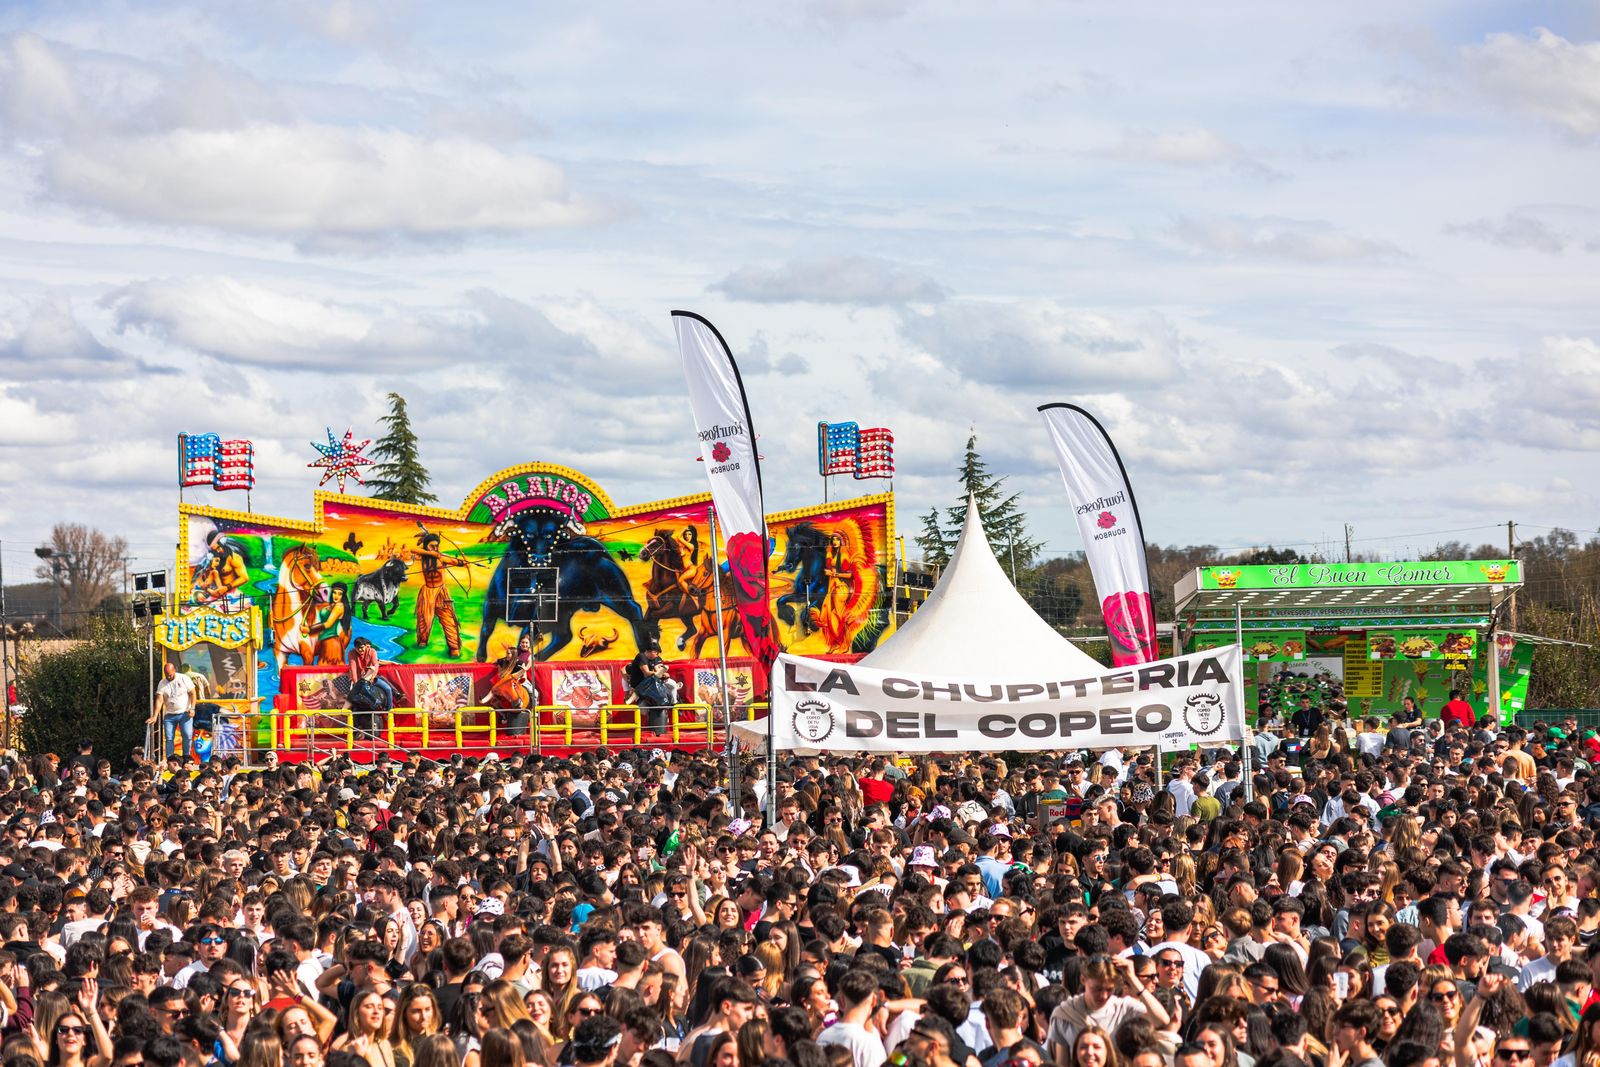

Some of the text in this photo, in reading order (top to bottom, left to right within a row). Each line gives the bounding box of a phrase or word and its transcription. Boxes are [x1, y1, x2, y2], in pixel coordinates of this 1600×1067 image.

[482, 476, 592, 516] BRAVOS
[1268, 564, 1453, 585] El Buen Comer
[162, 615, 250, 645] TIKETS
[784, 657, 1230, 702] LA CHUPITERIA
[846, 704, 1172, 738] DEL COPEO
[1049, 807, 1065, 817] Red
